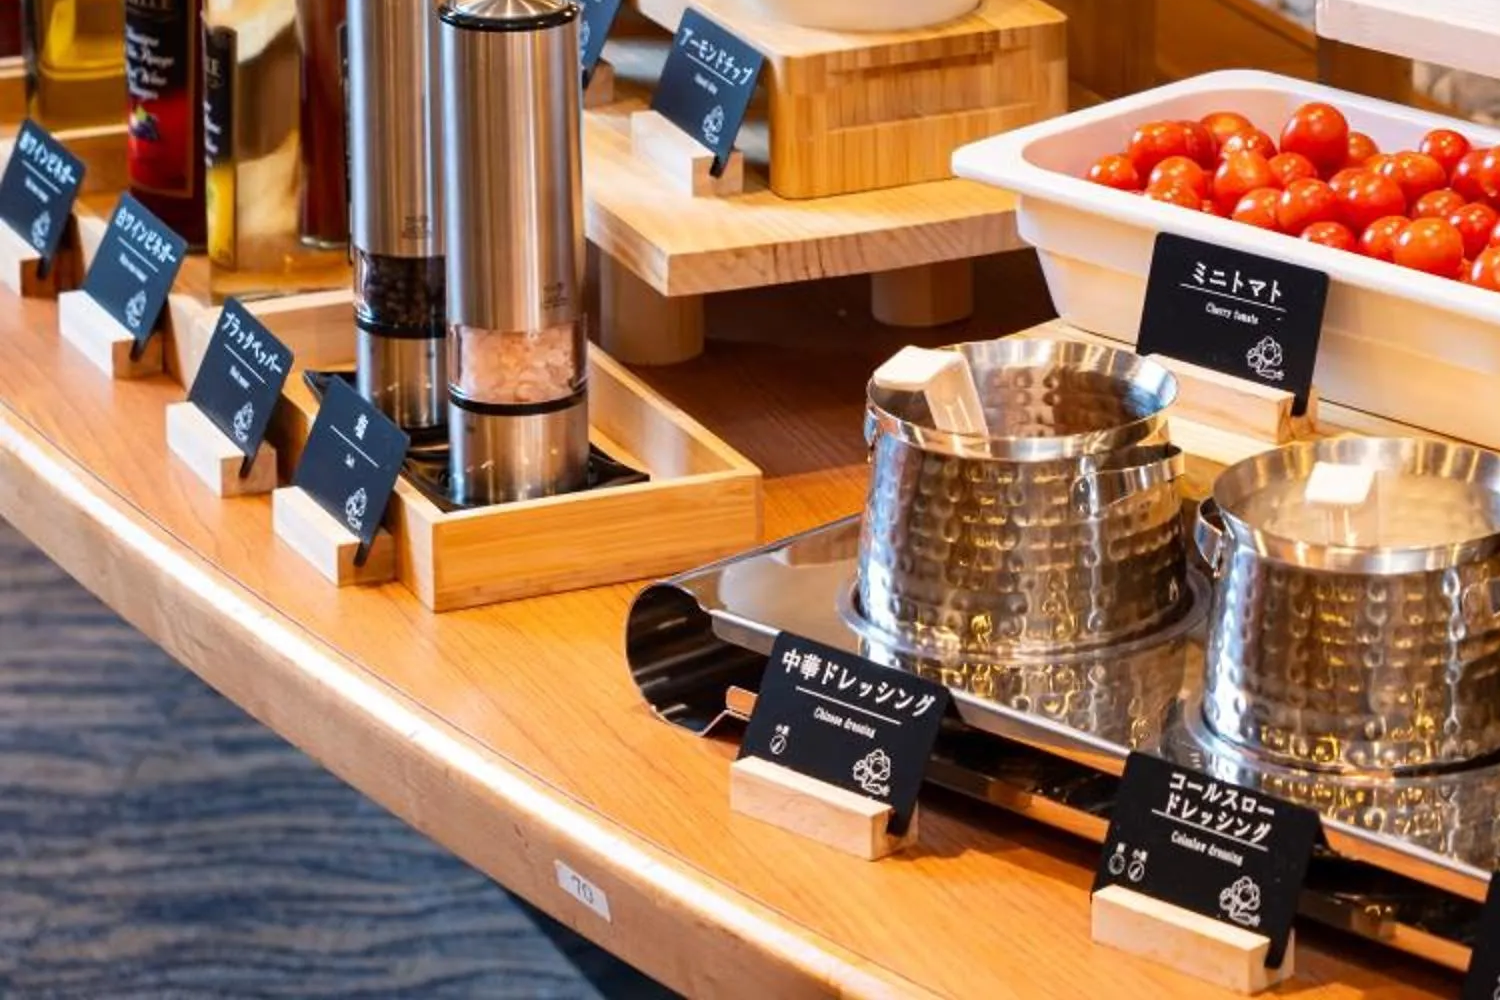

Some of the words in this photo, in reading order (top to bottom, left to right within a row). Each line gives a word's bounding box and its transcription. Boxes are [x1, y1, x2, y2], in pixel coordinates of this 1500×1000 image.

[680, 27, 754, 85] アーモンドチップ
[115, 206, 176, 263] 白ワインビネガー
[1192, 261, 1282, 304] ミニトマト
[221, 312, 283, 374] ブラックペッパー
[781, 647, 936, 717] 中華ドレッシング
[1164, 793, 1272, 844] ドレッシング
[1169, 772, 1276, 816] コールスロー
